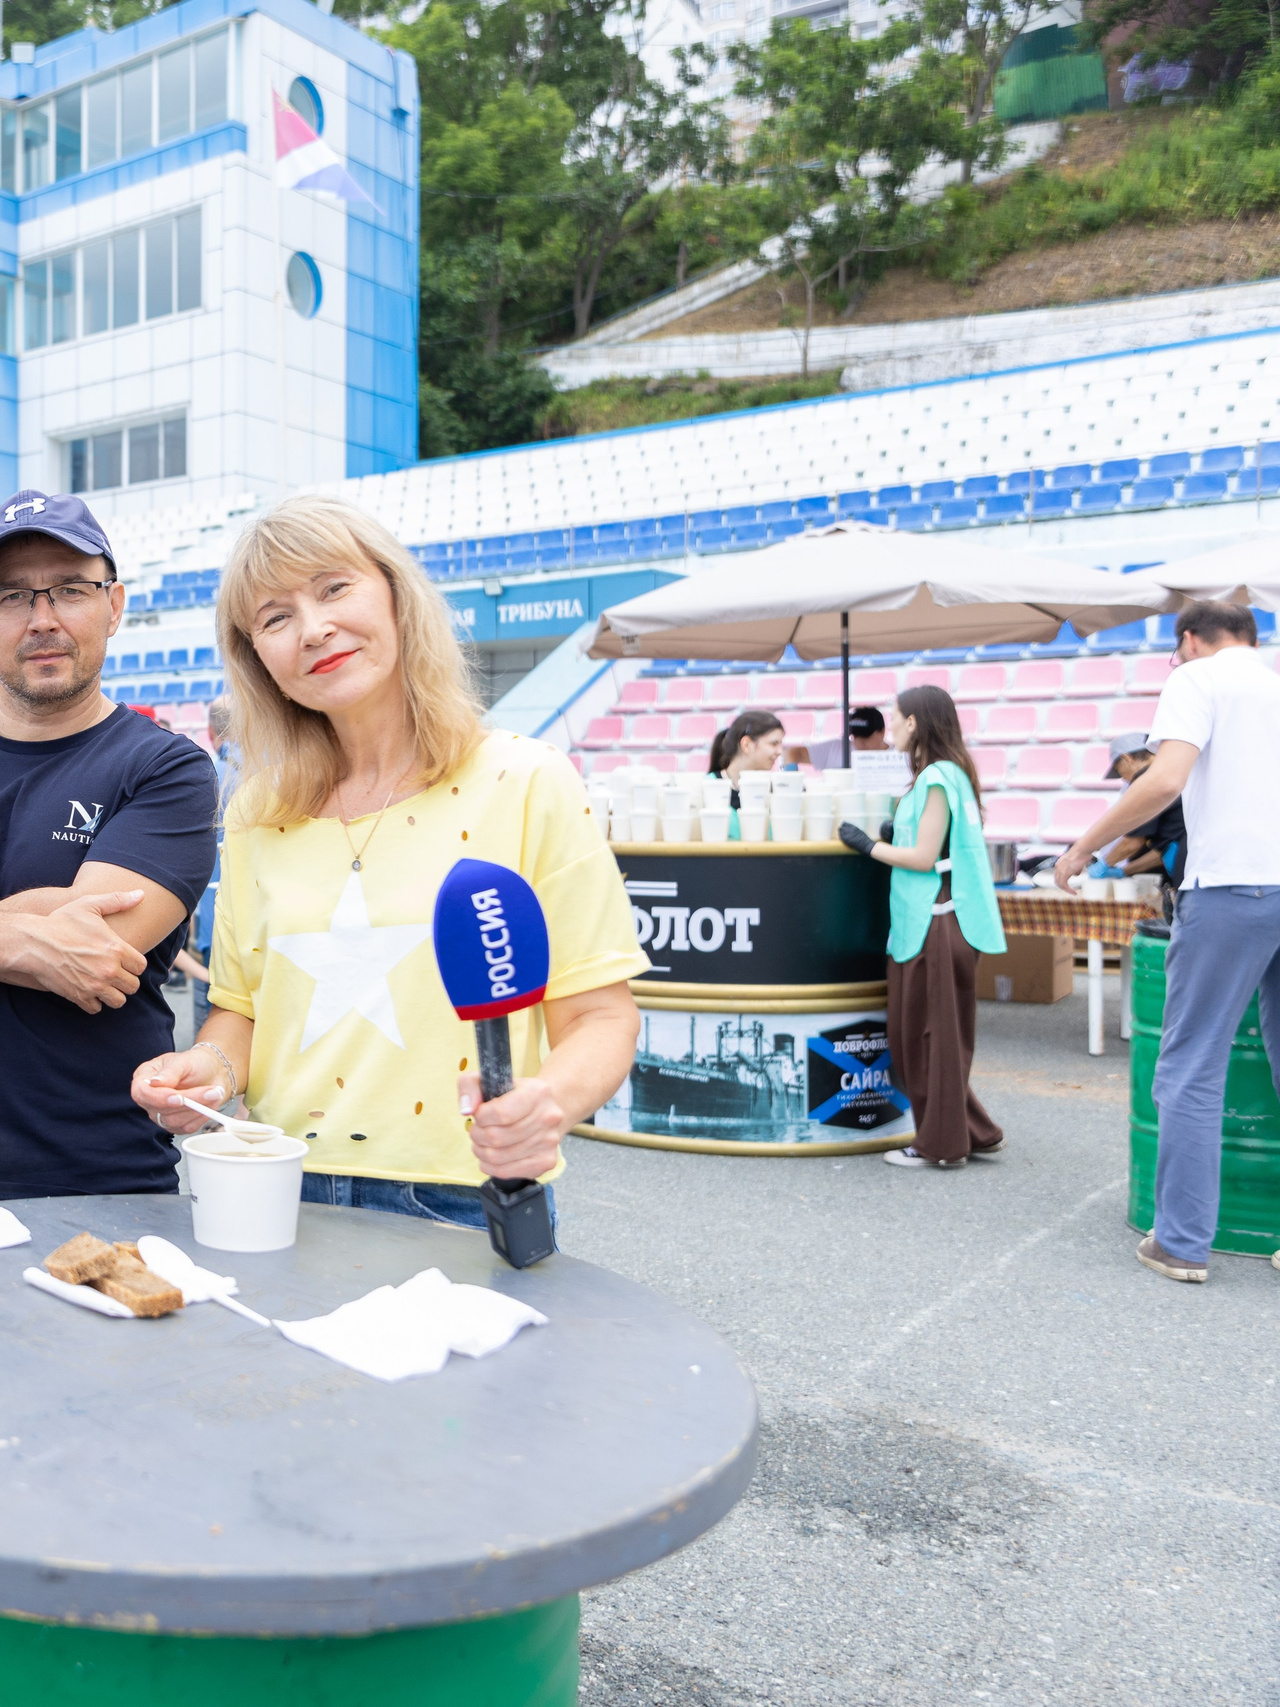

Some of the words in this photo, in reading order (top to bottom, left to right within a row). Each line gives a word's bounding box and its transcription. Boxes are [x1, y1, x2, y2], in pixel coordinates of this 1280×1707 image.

[497, 598, 584, 623] ТРИБУНА
[471, 888, 518, 998] РОССИЯ
[840, 1066, 891, 1091] САЙРА
